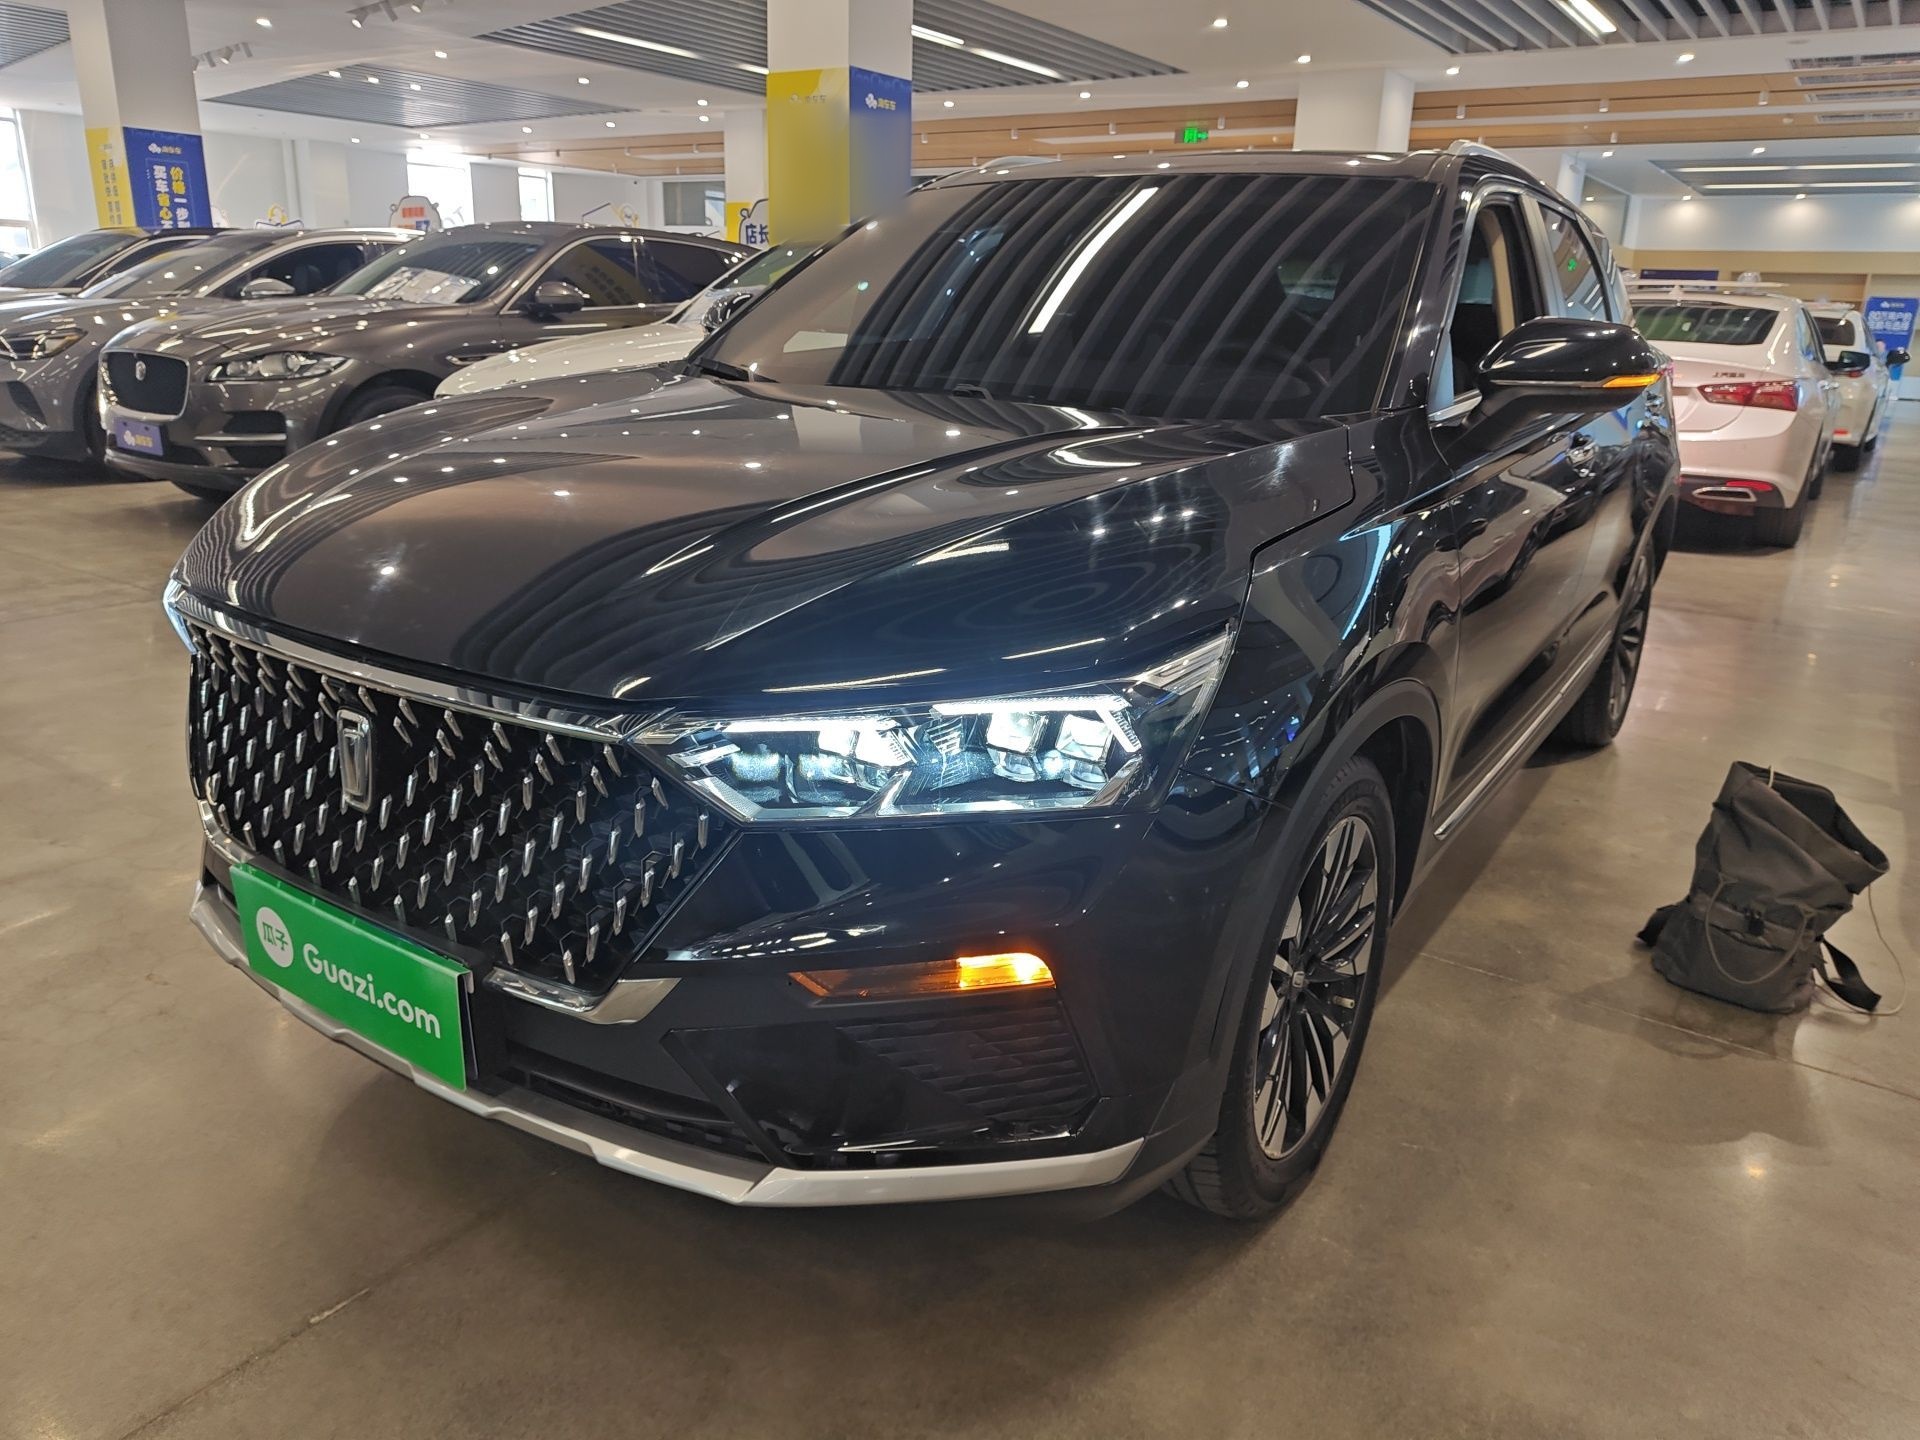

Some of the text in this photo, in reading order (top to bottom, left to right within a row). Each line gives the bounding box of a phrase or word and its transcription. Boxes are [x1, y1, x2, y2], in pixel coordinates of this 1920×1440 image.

[745, 224, 769, 244] 店长
[262, 921, 289, 950] 瓜子
[303, 943, 441, 1039] Guazi.com
